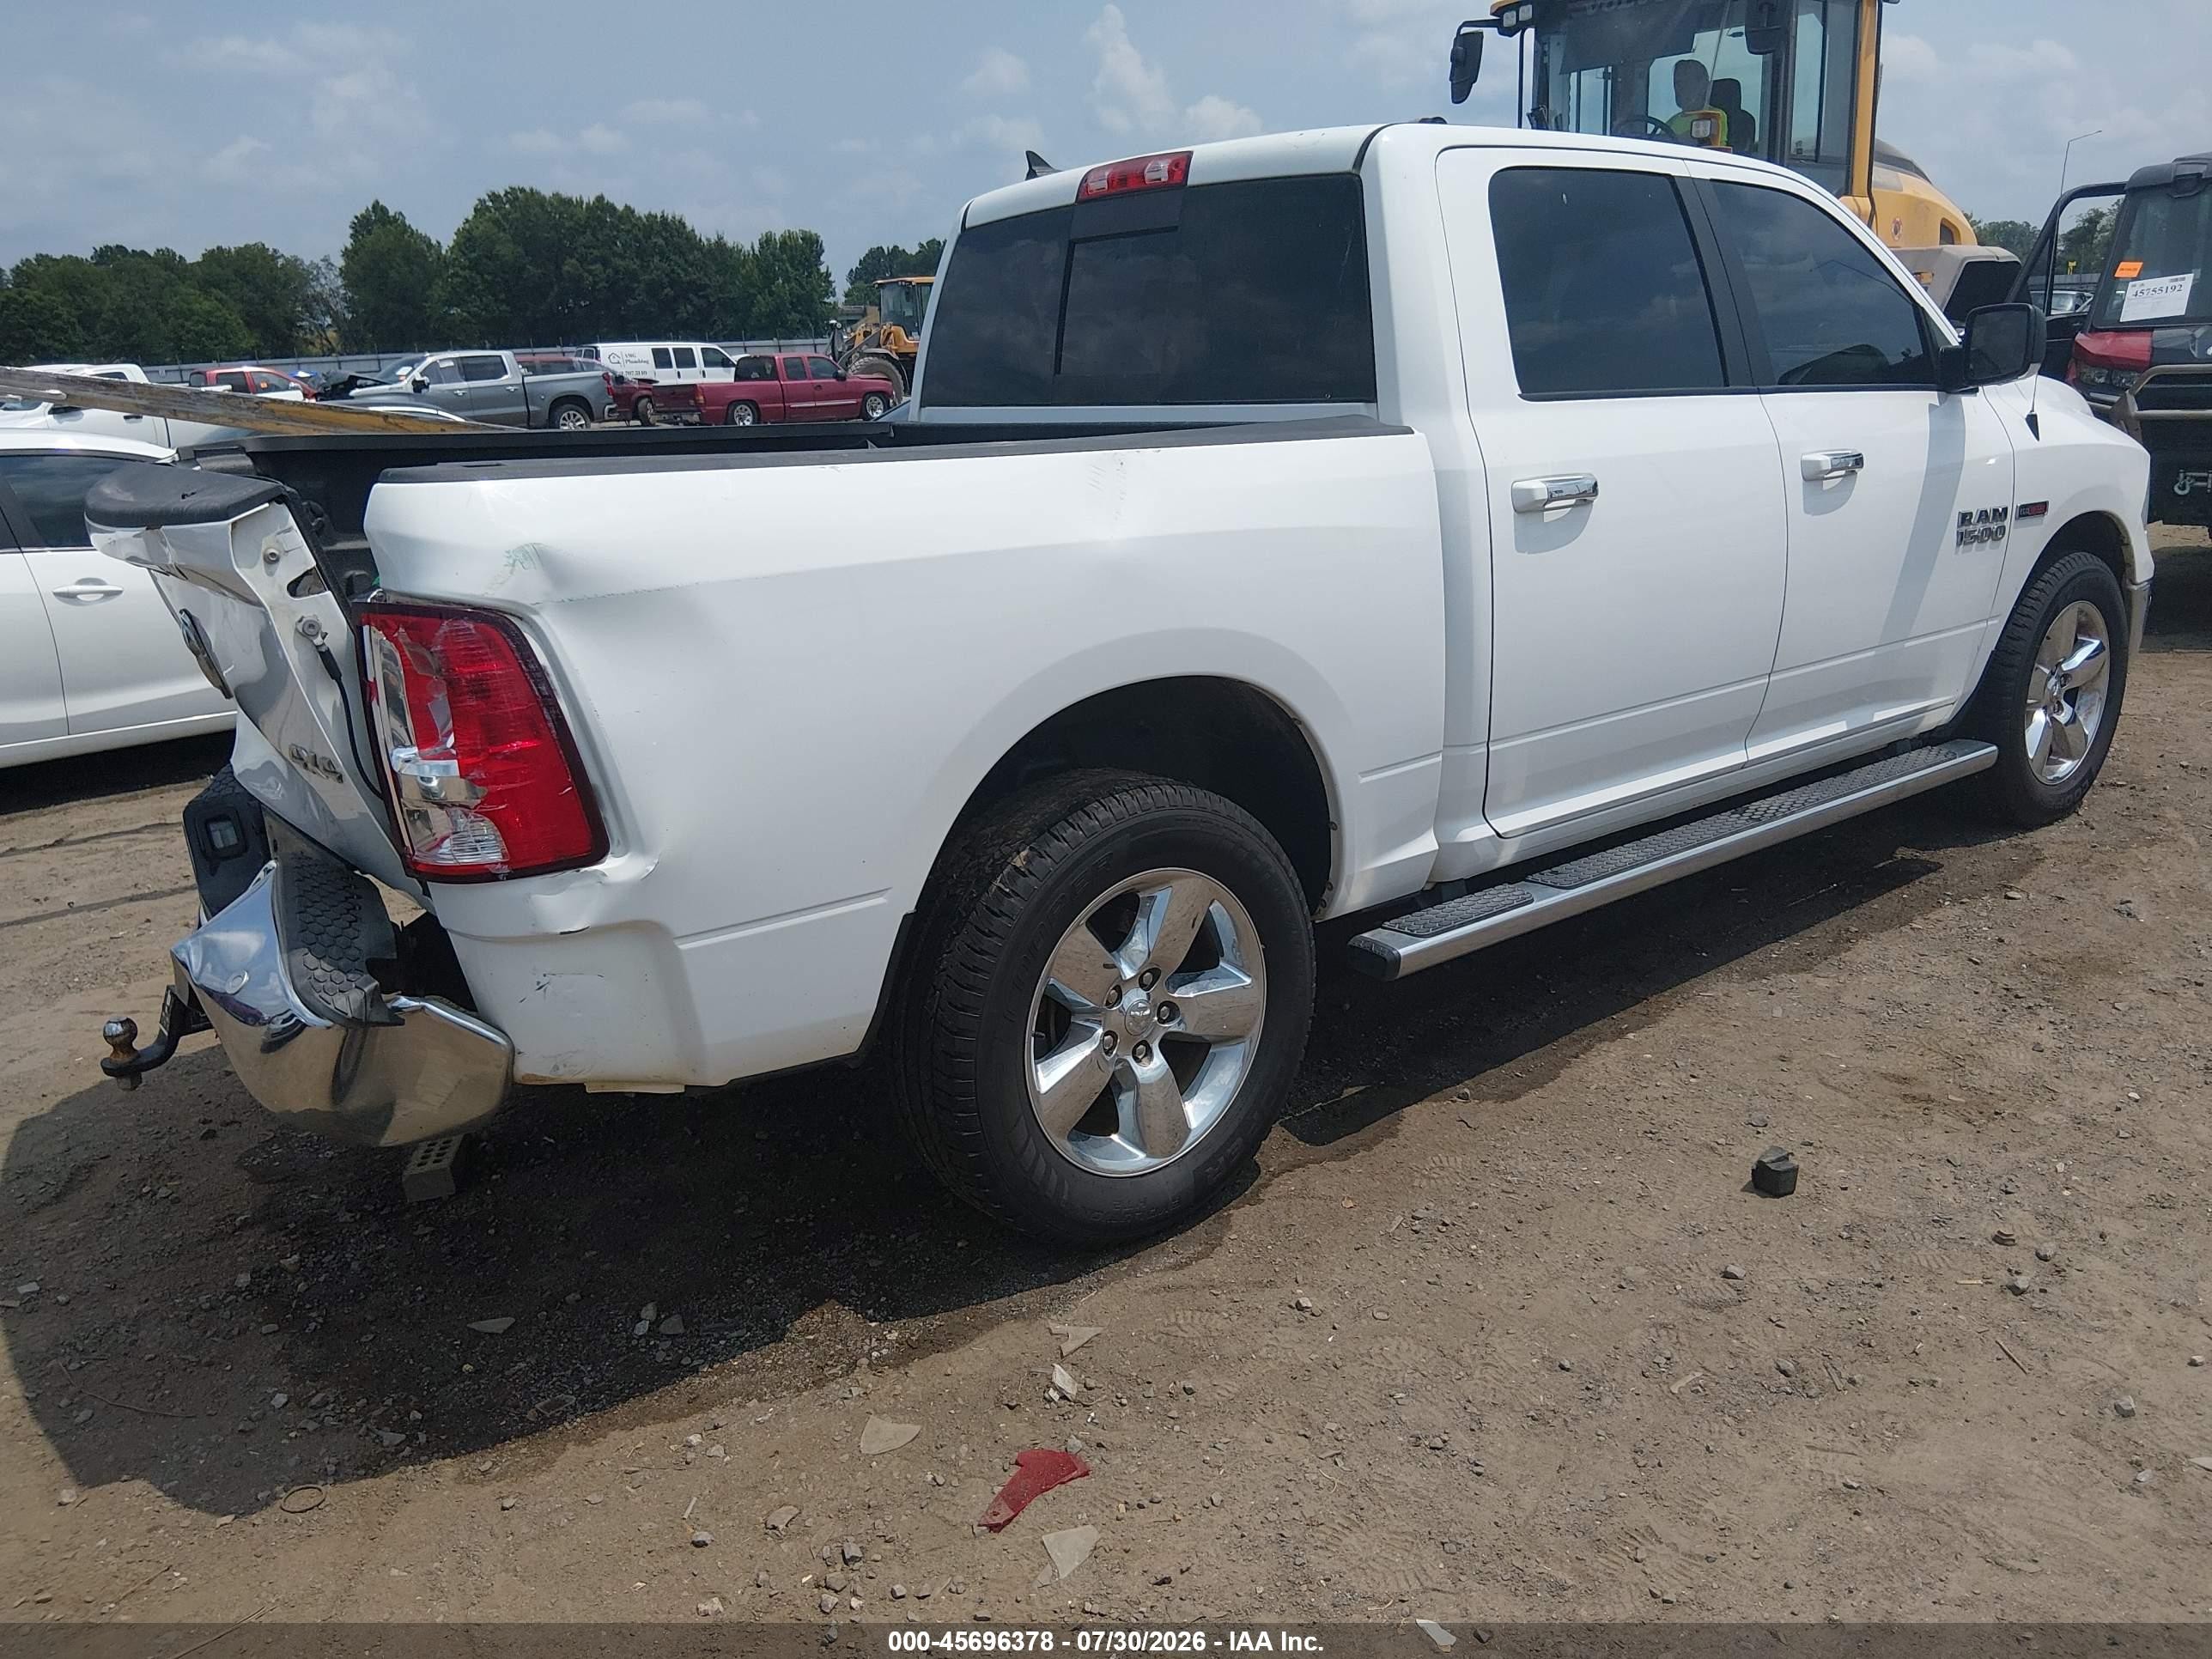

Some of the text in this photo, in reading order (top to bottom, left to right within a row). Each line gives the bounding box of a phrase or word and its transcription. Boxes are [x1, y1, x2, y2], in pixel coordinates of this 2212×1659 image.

[2132, 284, 2183, 298] 45755192
[1957, 506, 2008, 527] RAM
[1956, 525, 2006, 548] 1500
